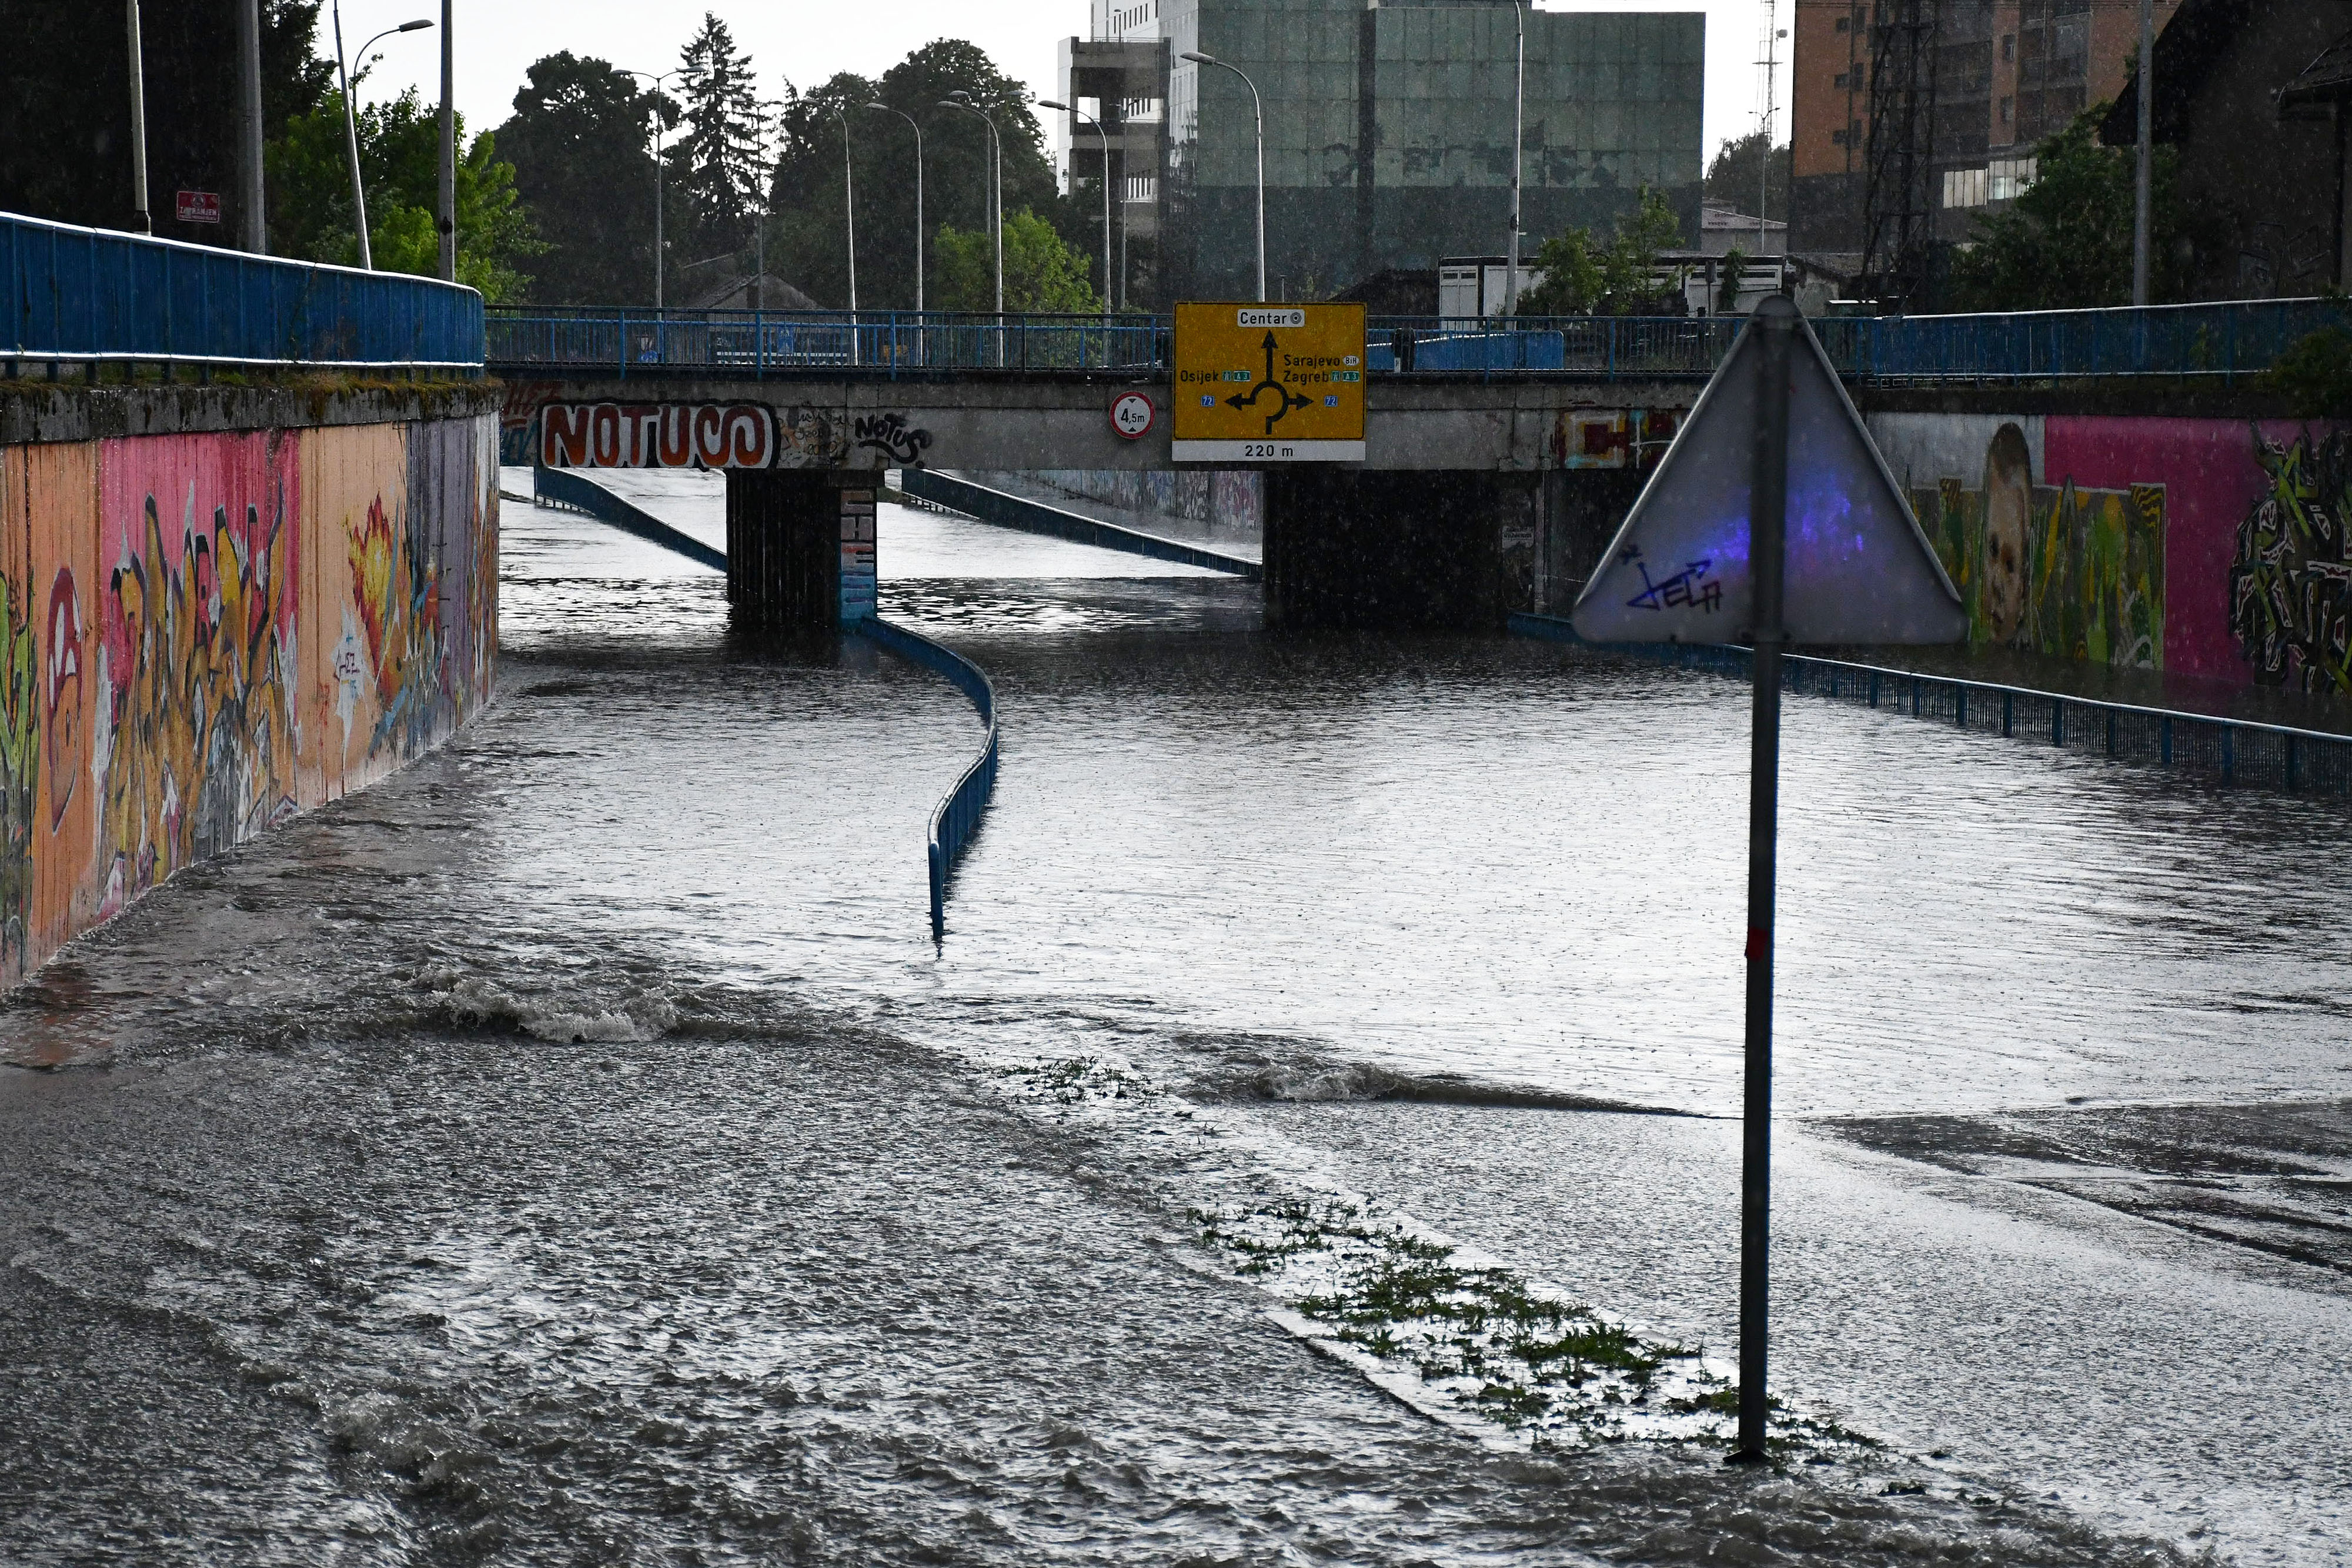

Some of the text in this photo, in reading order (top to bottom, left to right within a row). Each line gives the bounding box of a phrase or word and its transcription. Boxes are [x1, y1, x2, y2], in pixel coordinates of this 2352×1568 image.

[1240, 312, 1287, 324] Centar
[1284, 354, 1340, 369] Sarajevo
[1180, 370, 1218, 385] Osijek
[1283, 370, 1329, 385] Zagreb
[1202, 397, 1212, 405] 72
[1326, 397, 1336, 406] 72
[1121, 408, 1145, 424] 4,5m
[1245, 444, 1293, 457] 220 m
